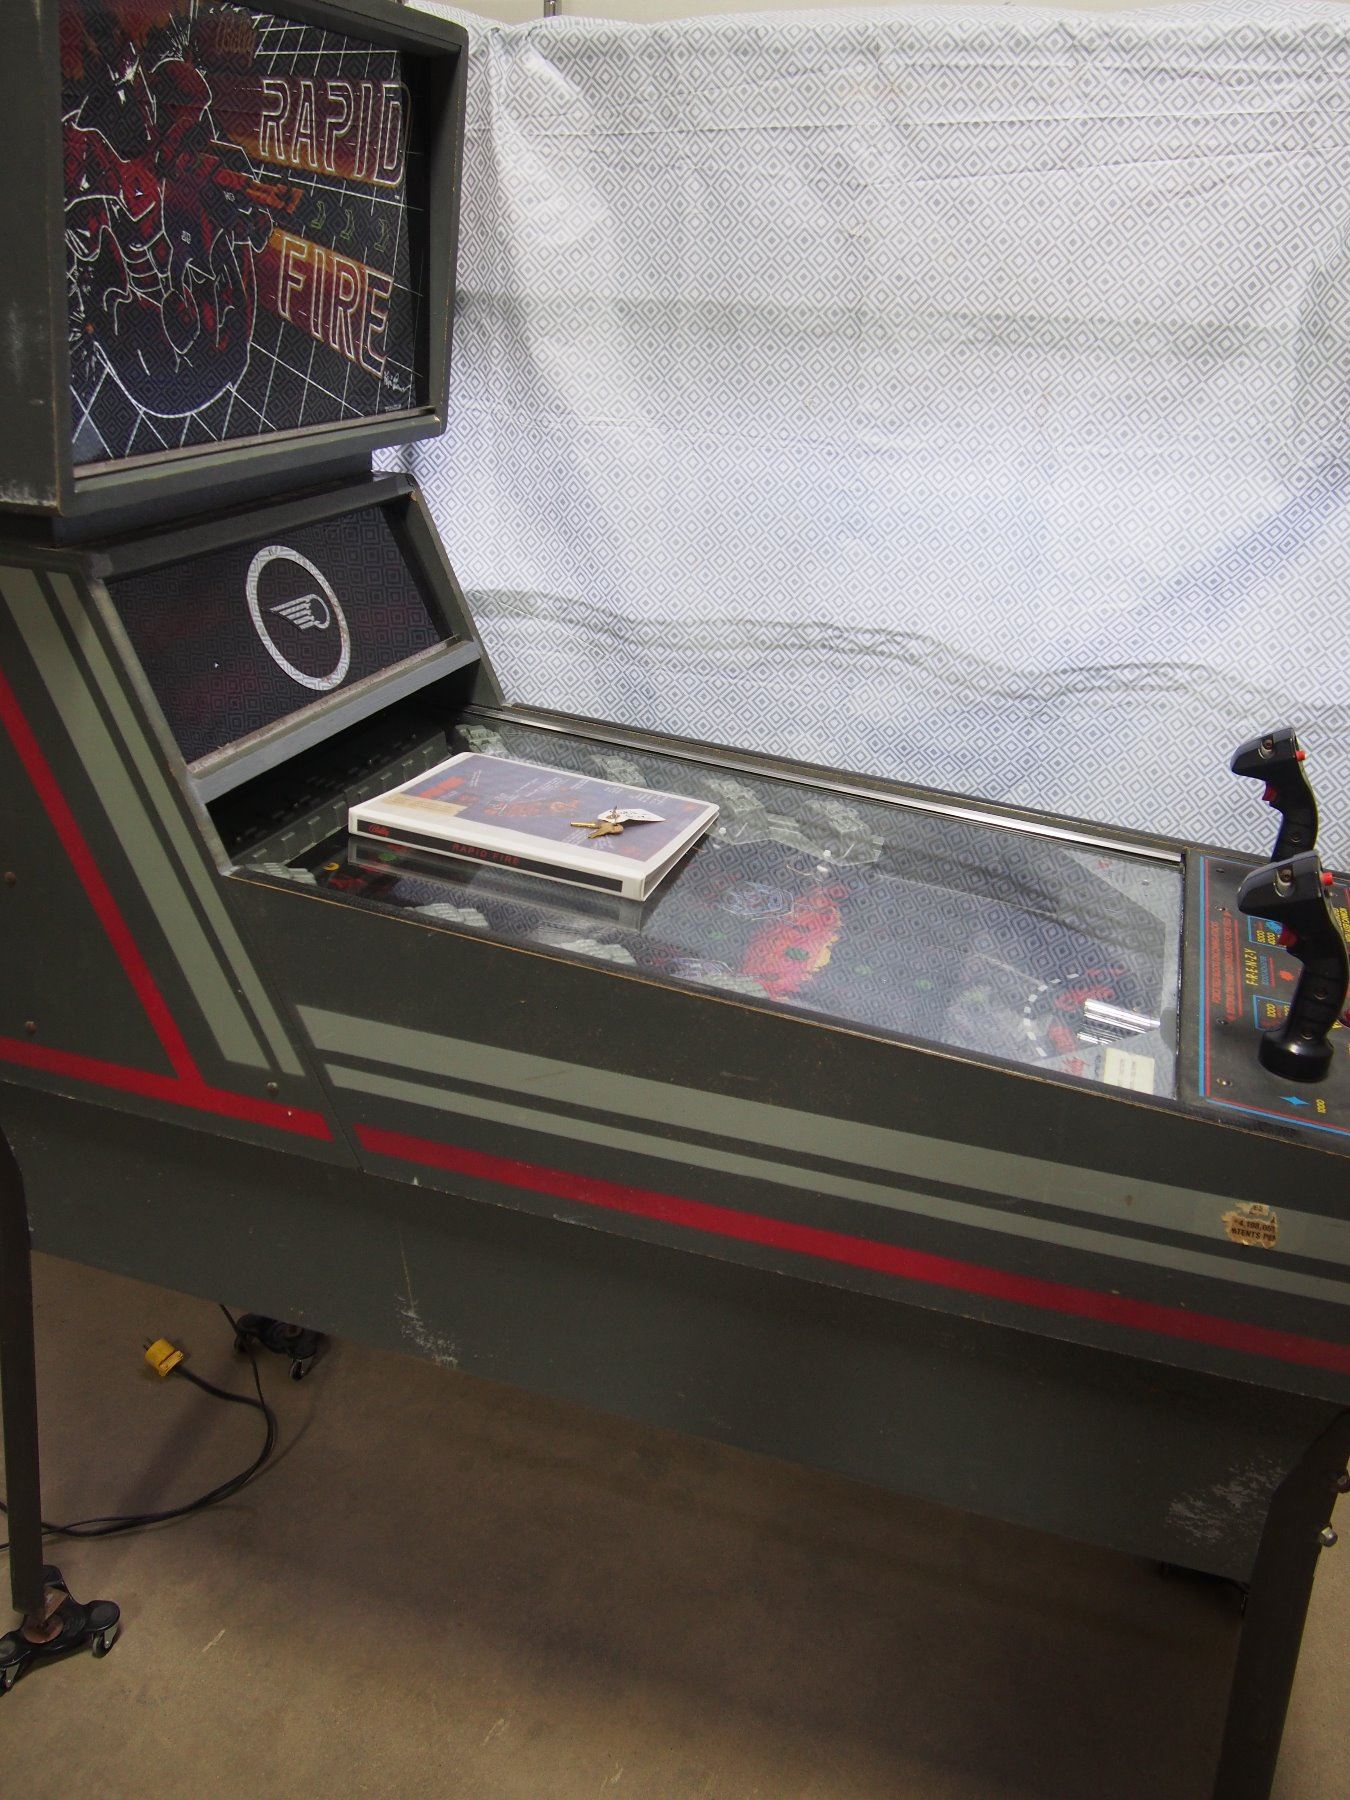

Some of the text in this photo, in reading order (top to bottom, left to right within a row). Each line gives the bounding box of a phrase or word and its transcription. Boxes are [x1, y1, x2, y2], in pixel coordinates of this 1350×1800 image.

[259, 79, 406, 186] RAPID
[278, 234, 395, 377] FIRE
[452, 843, 520, 865] RAPID FIRE
